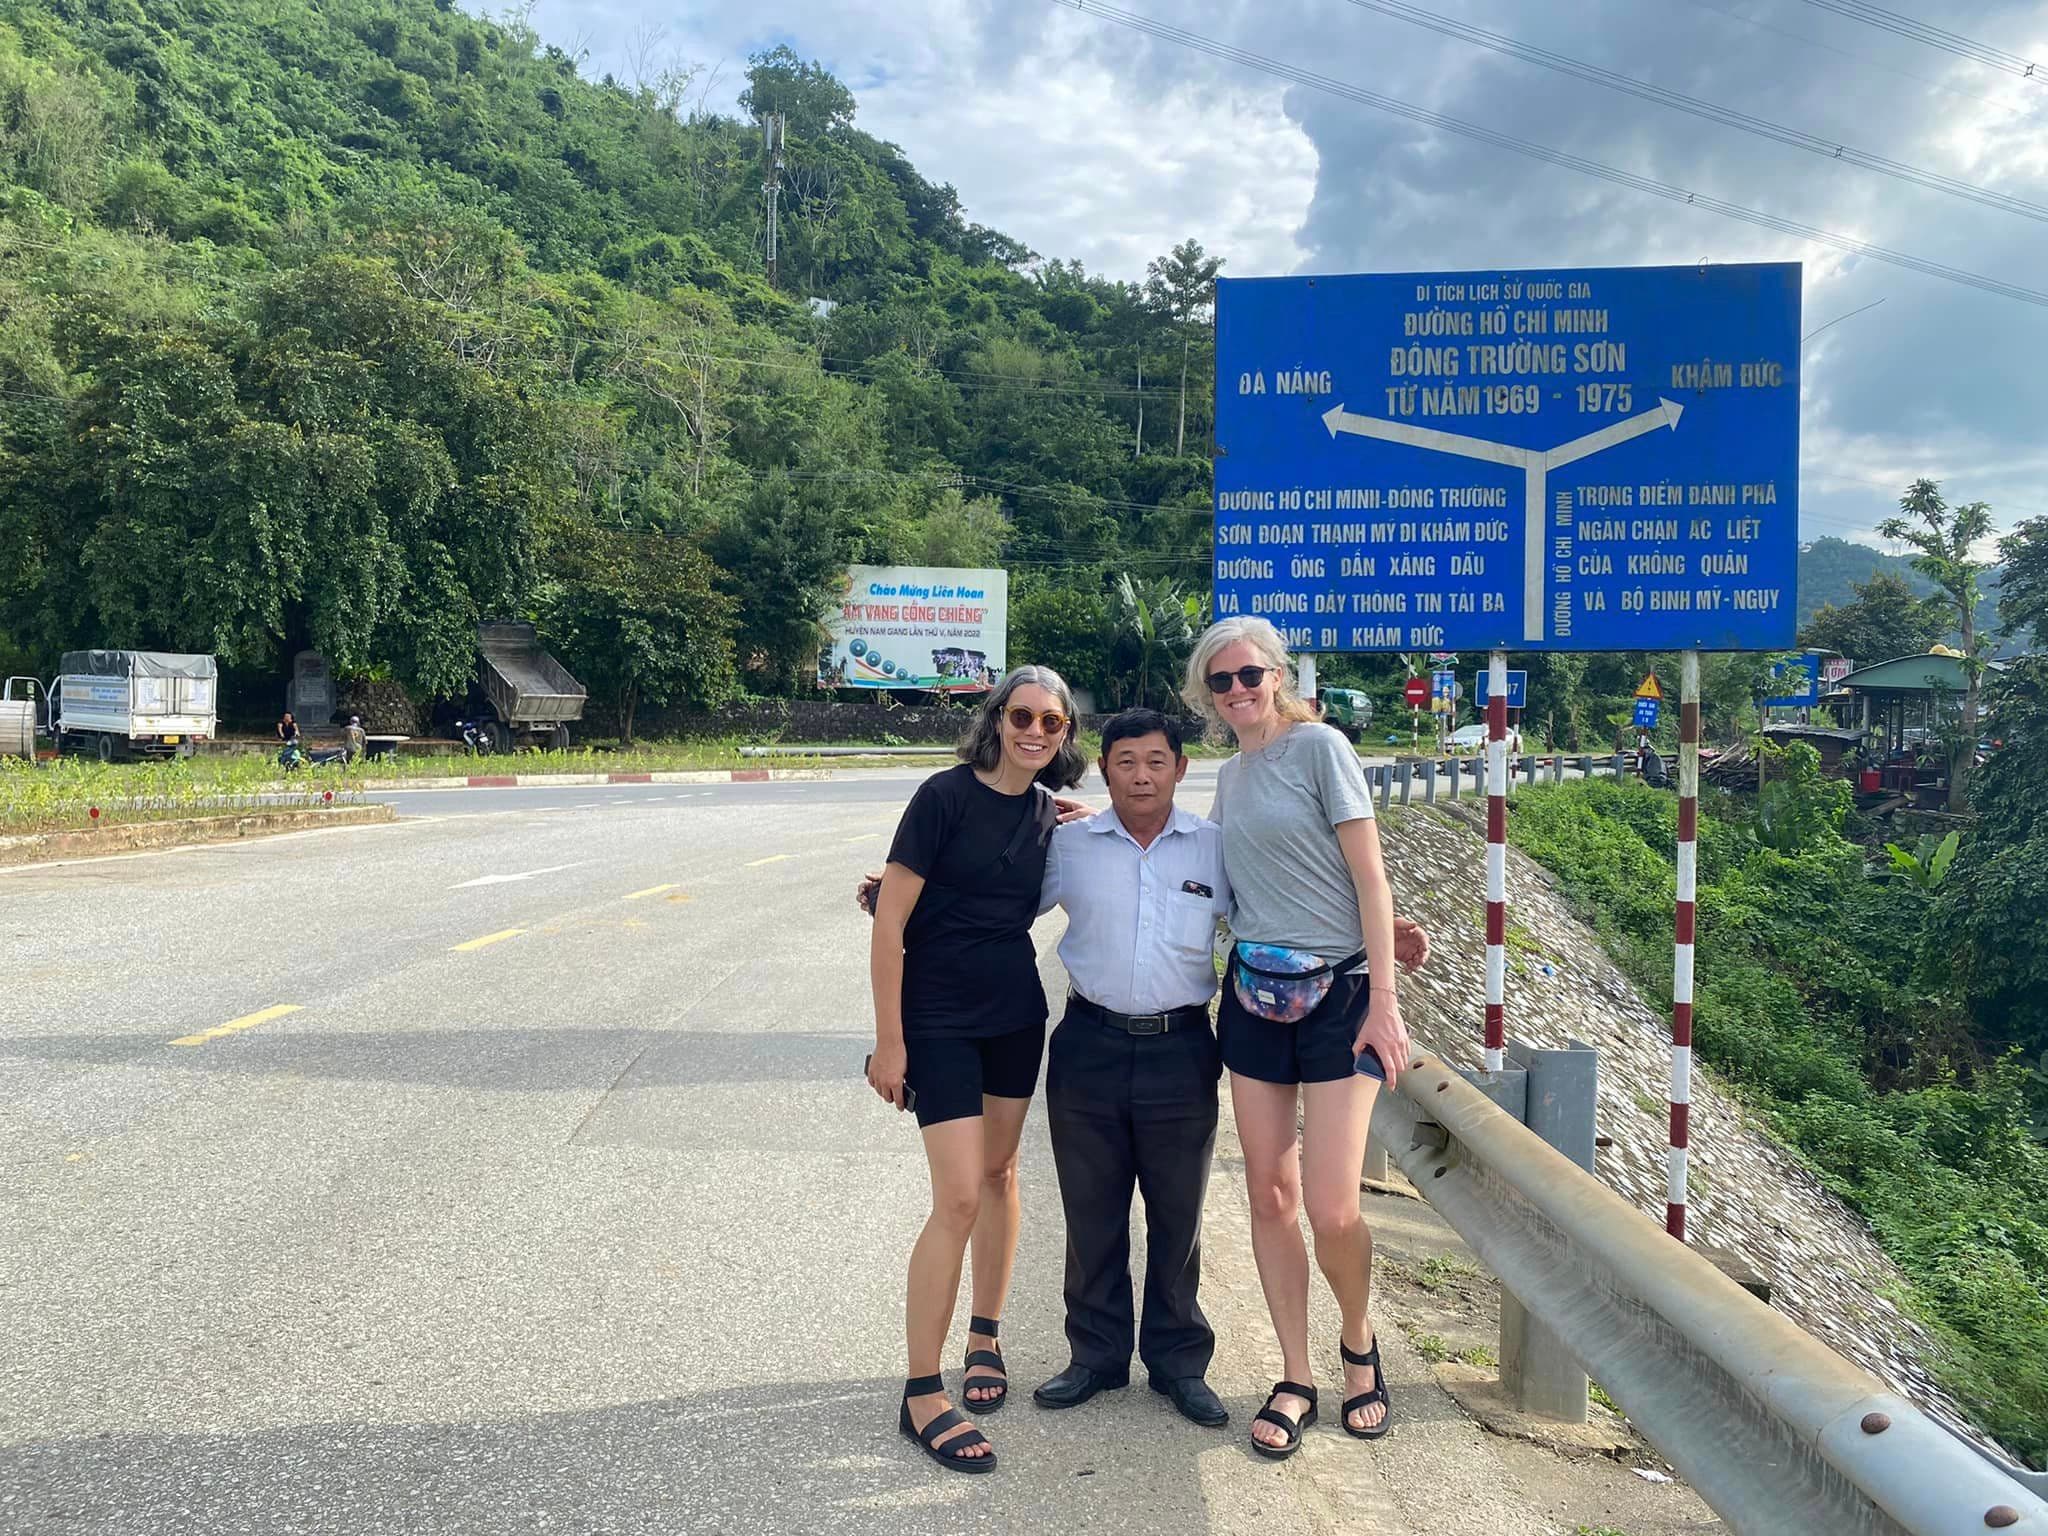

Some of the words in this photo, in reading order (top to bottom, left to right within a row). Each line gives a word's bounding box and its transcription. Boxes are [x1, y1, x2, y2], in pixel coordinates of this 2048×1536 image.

[1435, 281, 1464, 301] TÍCH
[1469, 284, 1499, 304] LỊCH
[1568, 282, 1591, 299] GIA
[1404, 306, 1473, 336] ĐƯỜNG
[1479, 304, 1510, 335] HỒ
[1514, 304, 1547, 334] CHÍ
[1554, 309, 1608, 334] MINH
[1390, 341, 1459, 376] ĐÔNG
[1467, 337, 1566, 375] TRƯỜNG
[1573, 339, 1626, 373] SƠN
[1671, 358, 1732, 388] KHÂM
[1740, 357, 1783, 388] ĐỨC
[1422, 380, 1480, 416] NĂM
[1483, 385, 1539, 415] 1969
[1576, 383, 1632, 413] 1975
[1219, 485, 1274, 511] ĐƯỜNG
[1440, 484, 1507, 508] TRƯỜNG
[1556, 491, 1573, 526] MINH
[1577, 486, 1633, 511] TRỌNG
[1639, 479, 1683, 506] ĐIỂM
[1742, 479, 1776, 505] PHÁ
[1218, 523, 1252, 544] SƠN
[1258, 524, 1304, 548] ĐOẠN
[1311, 523, 1366, 548] THẠNH
[1421, 517, 1470, 542] KHÂM
[1475, 518, 1509, 542] ĐỨC
[1727, 515, 1761, 543] LIỆT
[1218, 555, 1273, 579] ĐƯỜNG
[1389, 552, 1435, 576] XĂNG
[1578, 548, 1613, 575] CỦA
[1627, 550, 1685, 575] KHÔNG
[1701, 549, 1748, 577] QUÂN
[956, 586, 984, 599] Hoan
[1218, 588, 1240, 613] VÀ
[1252, 589, 1308, 614] ĐƯỜNG
[1314, 589, 1346, 613] DÂY
[1352, 589, 1406, 613] THÔNG
[1415, 593, 1442, 613] TIN
[1482, 592, 1505, 612] BA
[1621, 585, 1644, 616] BỘ
[1650, 590, 1690, 610] BINH
[1321, 628, 1338, 647] ĐI
[1352, 623, 1401, 647] KHÂM
[1411, 623, 1444, 647] ĐỨC
